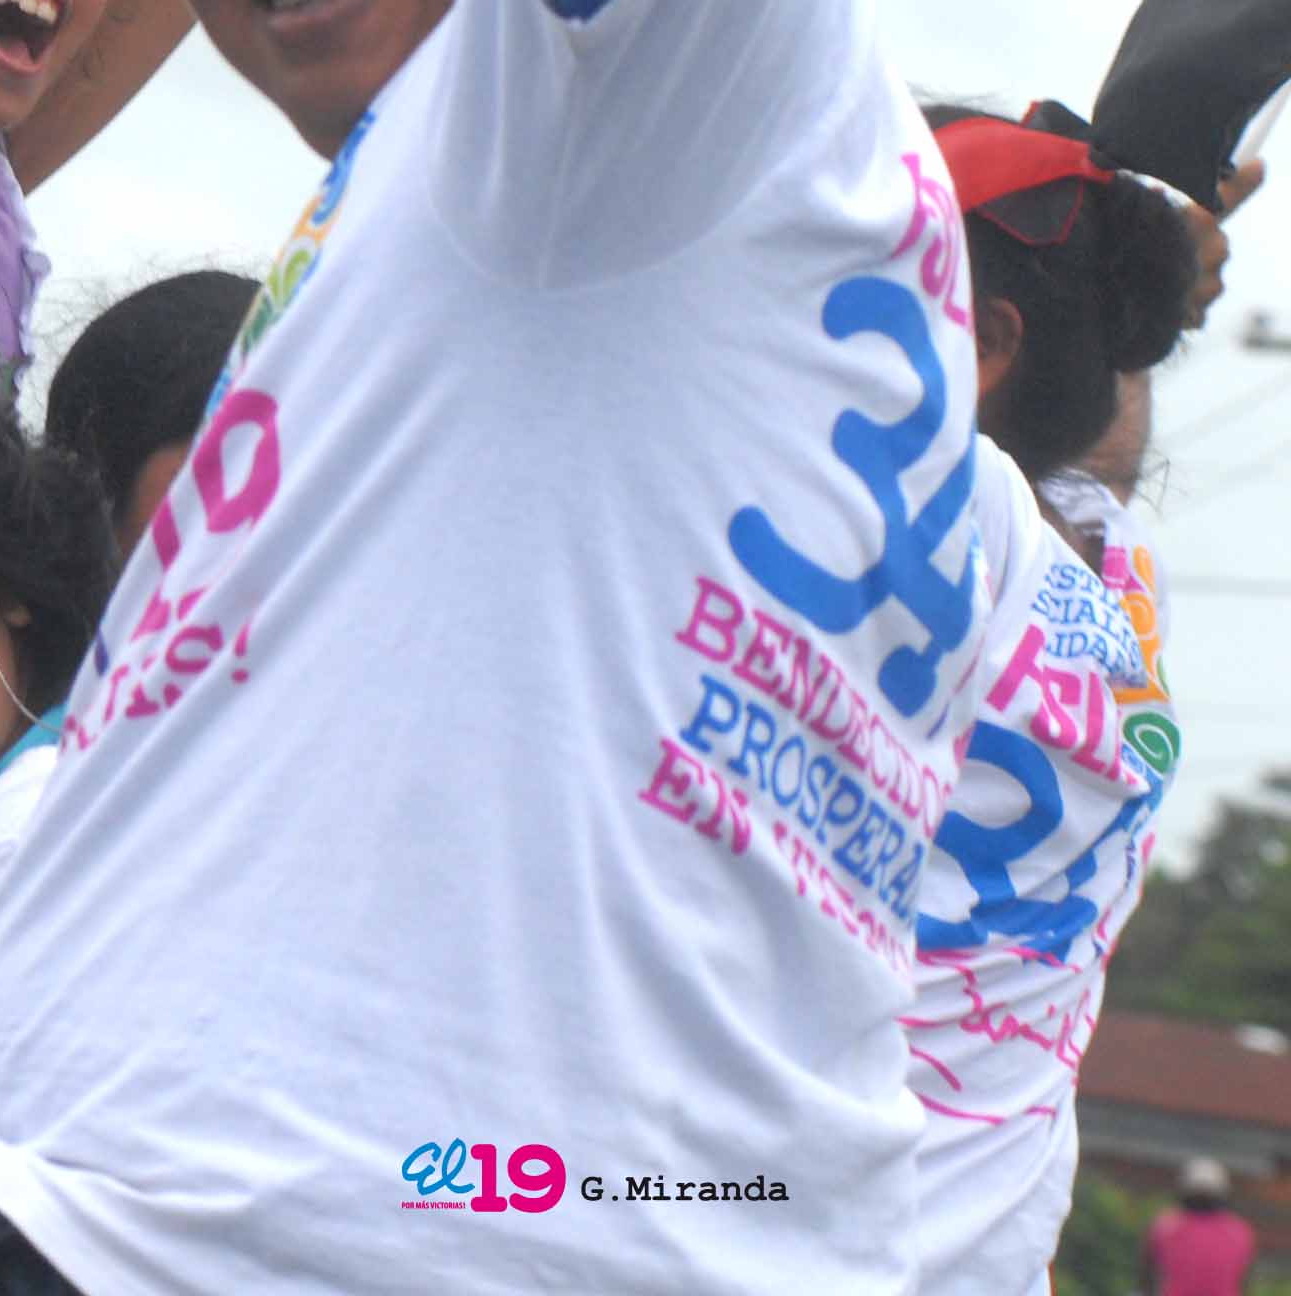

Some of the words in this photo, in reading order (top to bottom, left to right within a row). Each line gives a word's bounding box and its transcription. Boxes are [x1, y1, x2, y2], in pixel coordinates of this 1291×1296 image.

[638, 738, 750, 855] EN
[675, 576, 952, 838] BENDECIDO
[680, 674, 925, 921] PROSPERA
